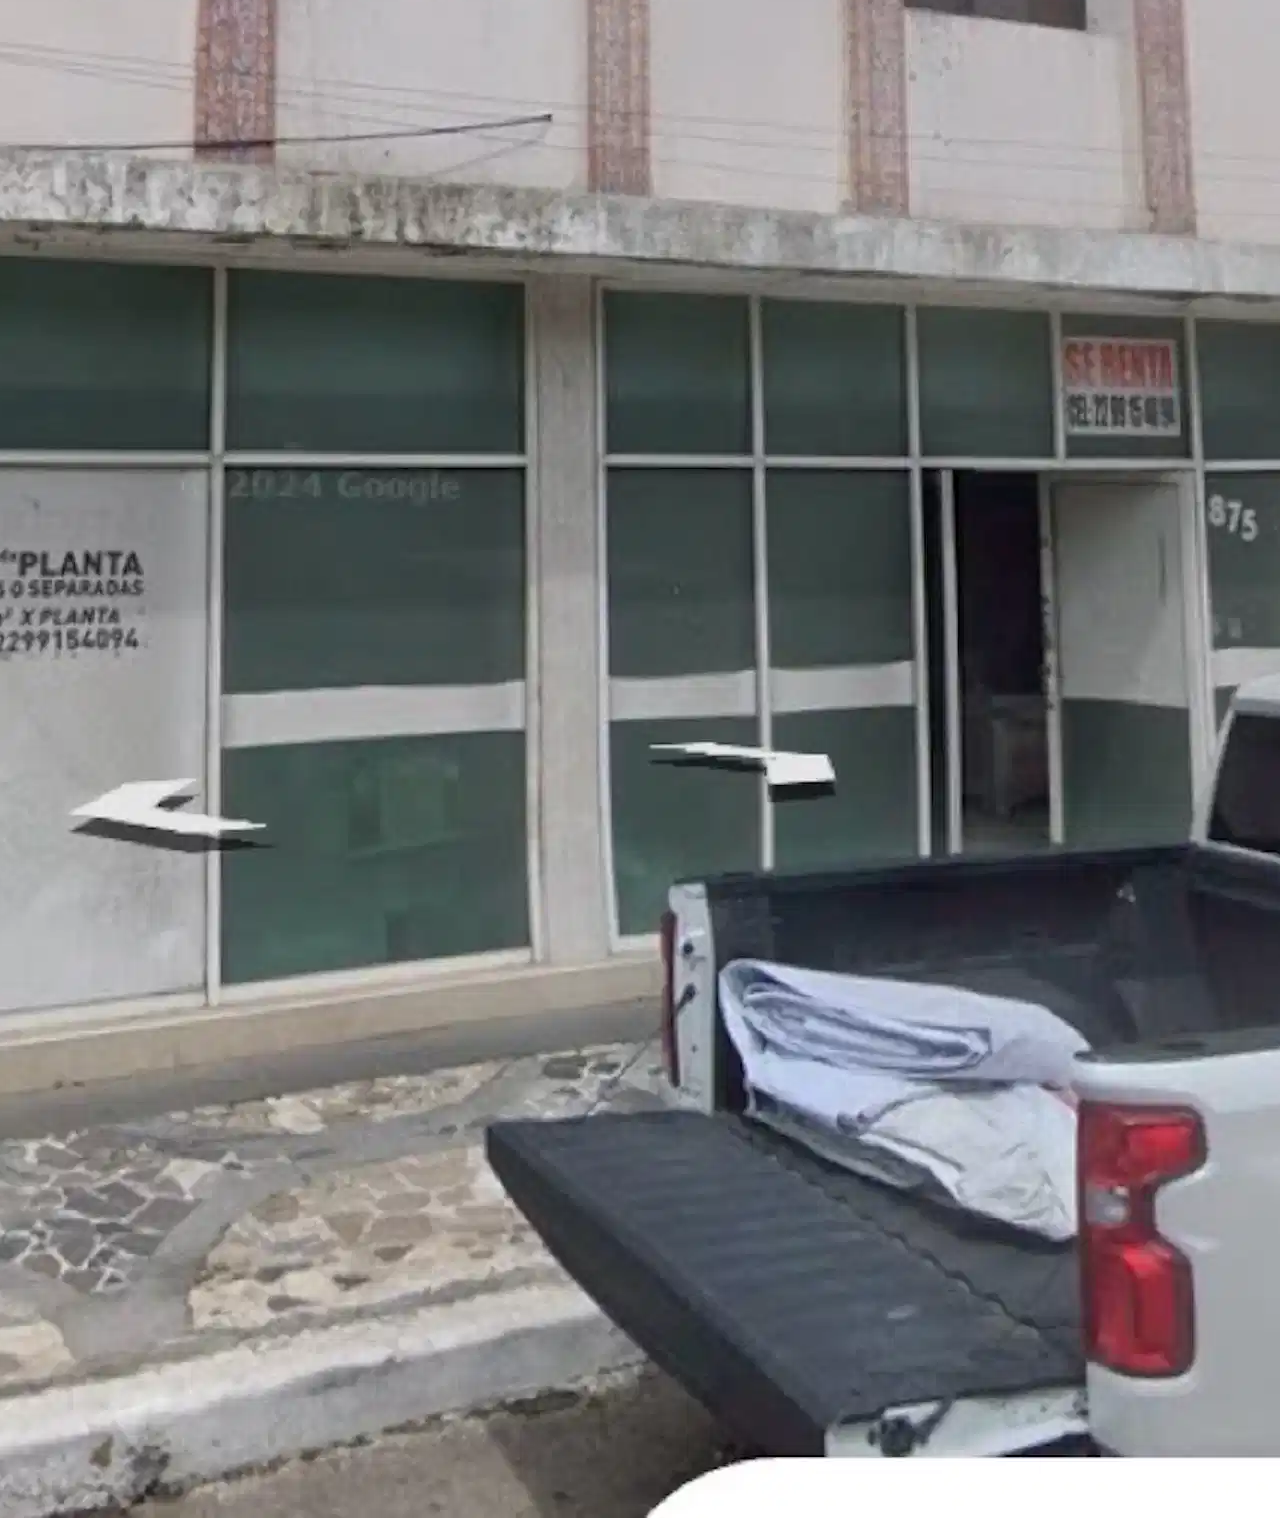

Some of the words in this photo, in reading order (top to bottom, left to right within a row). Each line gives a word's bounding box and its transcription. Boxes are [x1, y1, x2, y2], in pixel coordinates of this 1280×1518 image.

[1207, 493, 1260, 542] 875
[18, 549, 144, 578] PLANTA
[28, 578, 145, 599] SEPARADAS
[39, 605, 121, 626] PLANTA
